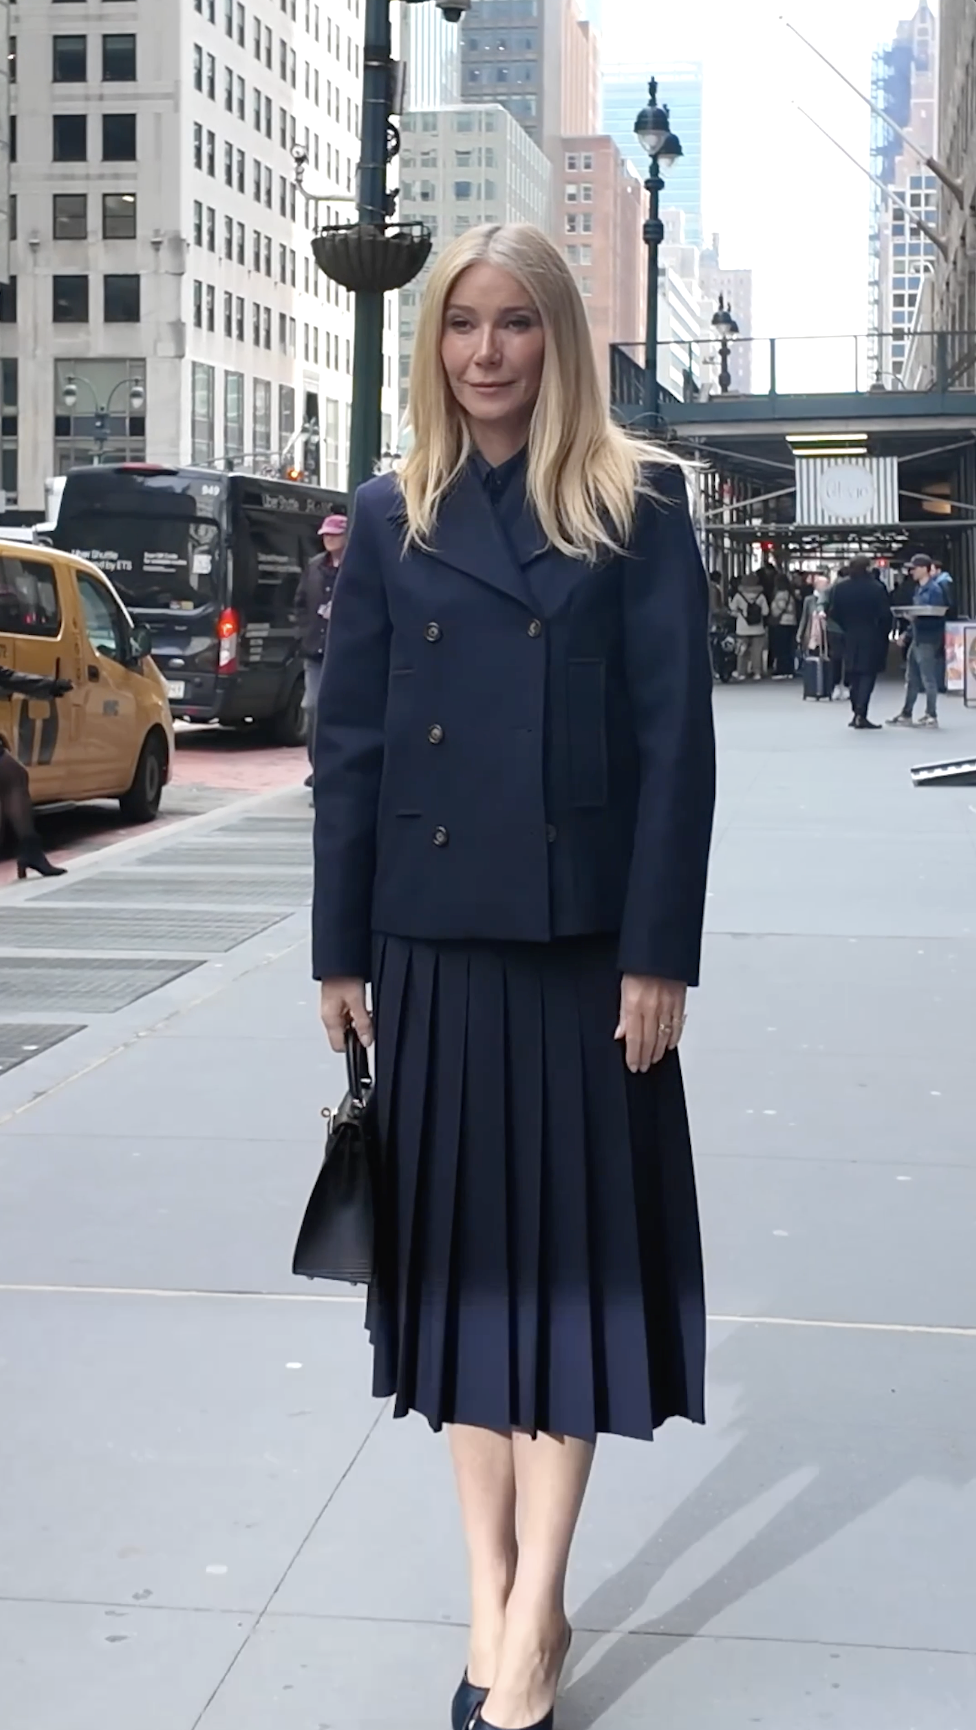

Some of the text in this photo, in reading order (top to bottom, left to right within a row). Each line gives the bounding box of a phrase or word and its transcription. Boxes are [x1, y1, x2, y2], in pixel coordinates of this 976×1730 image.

[201, 484, 221, 497] 949
[91, 549, 119, 561] Shuttle
[116, 559, 133, 572] ETS
